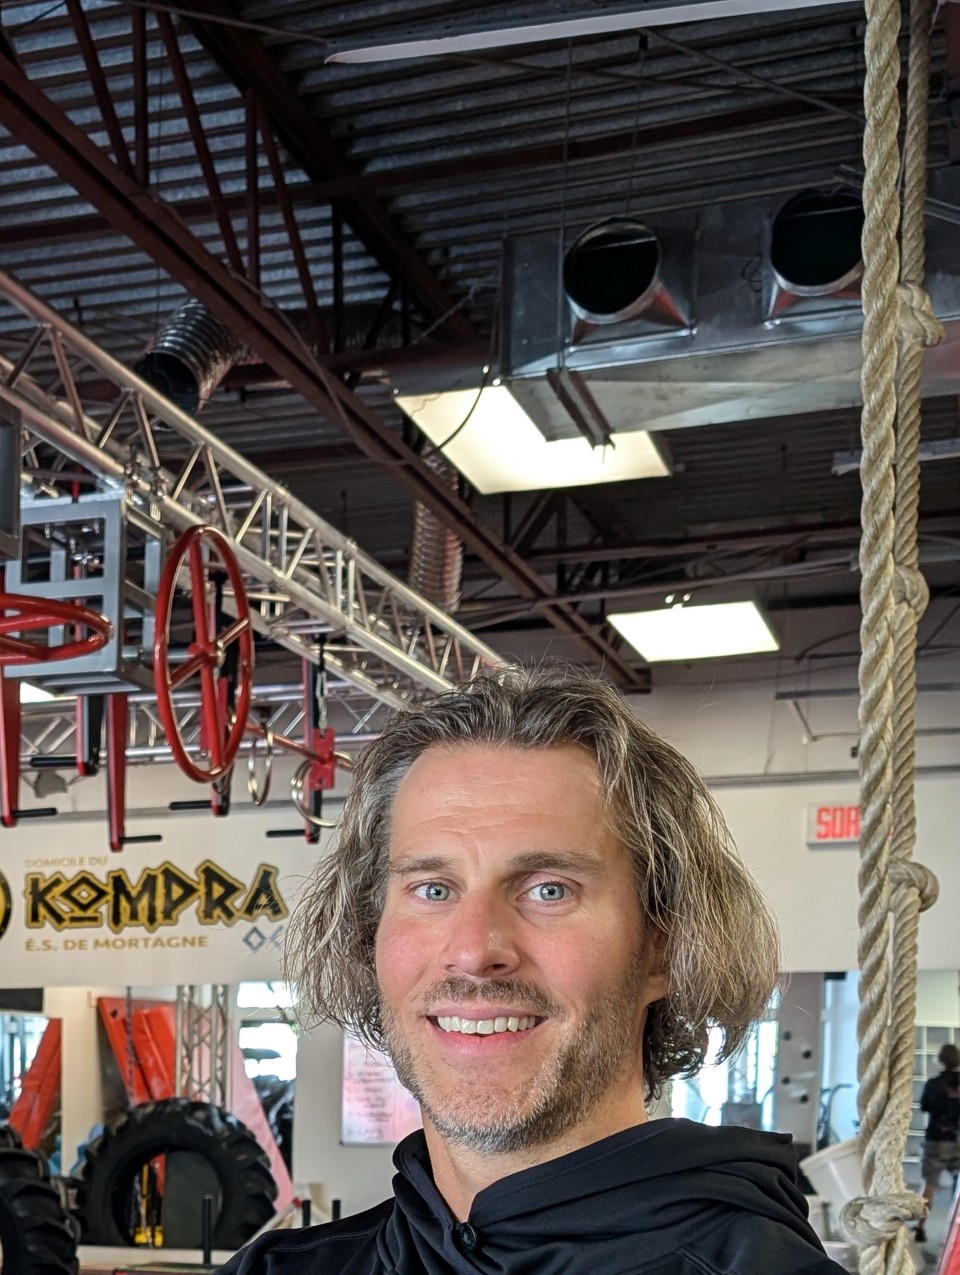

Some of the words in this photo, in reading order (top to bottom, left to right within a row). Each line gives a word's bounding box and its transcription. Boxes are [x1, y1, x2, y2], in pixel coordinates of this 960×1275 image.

[816, 805, 861, 839] SOR
[24, 857, 85, 868] DOMICILE
[88, 855, 109, 866] DU
[24, 860, 288, 933] KOMPRA
[63, 938, 88, 951] DE
[93, 935, 208, 950] MORTAGNE
